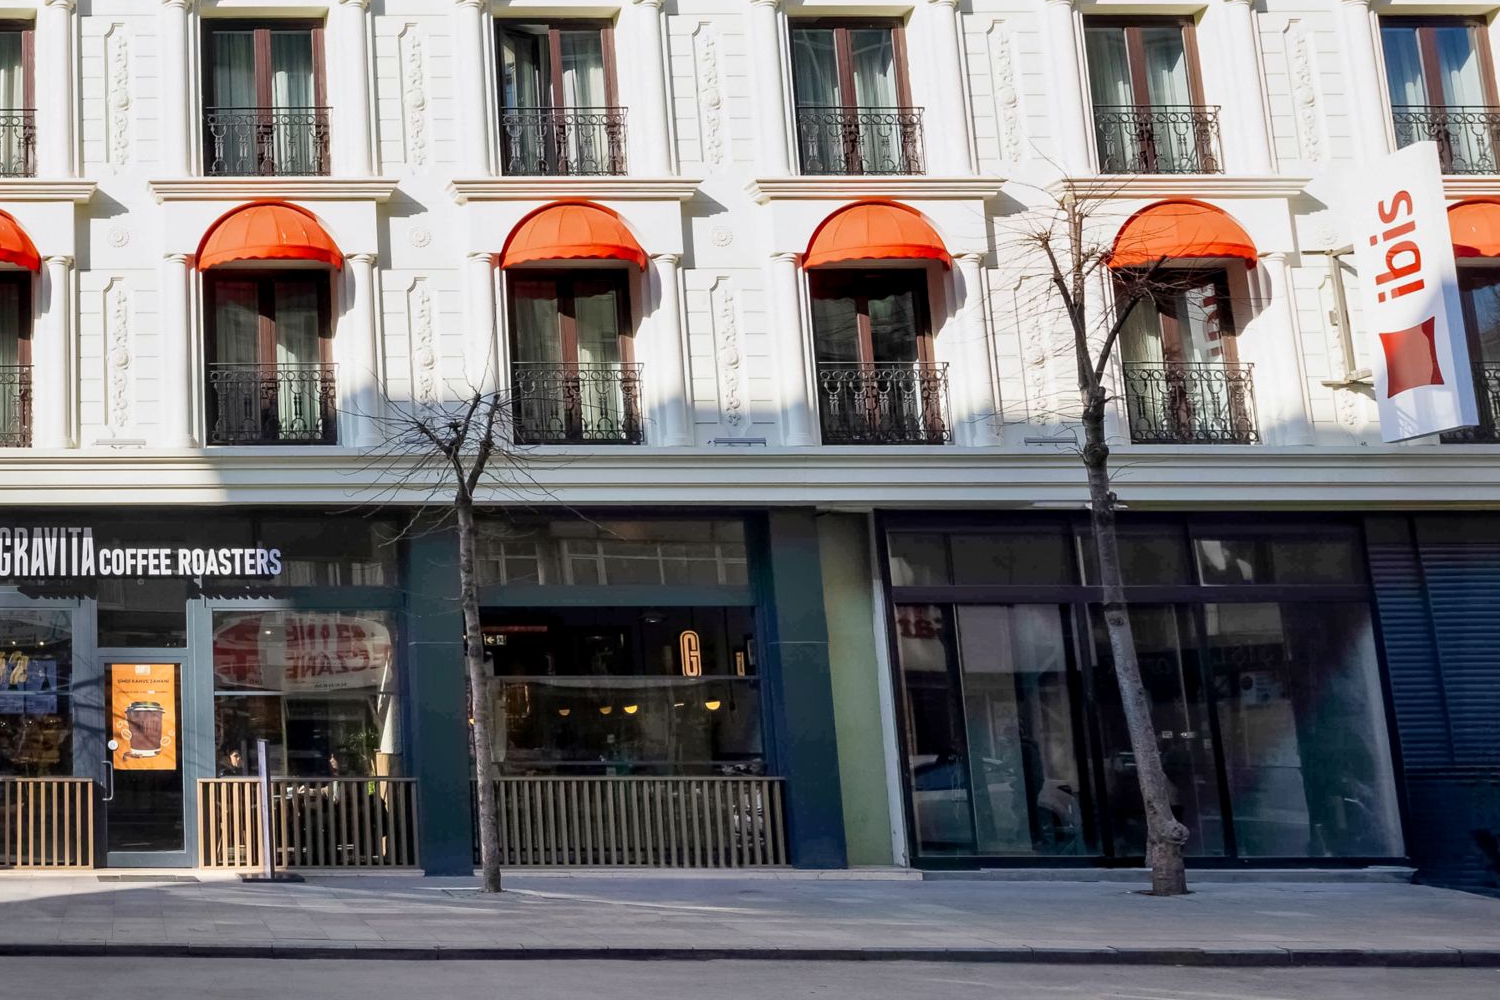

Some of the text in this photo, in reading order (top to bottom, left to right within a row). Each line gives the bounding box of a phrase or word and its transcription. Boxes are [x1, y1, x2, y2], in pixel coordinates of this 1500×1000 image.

[1369, 190, 1425, 303] ibis
[99, 548, 172, 575] COFFEE
[178, 548, 282, 576] ROASTERS
[681, 631, 701, 677] G
